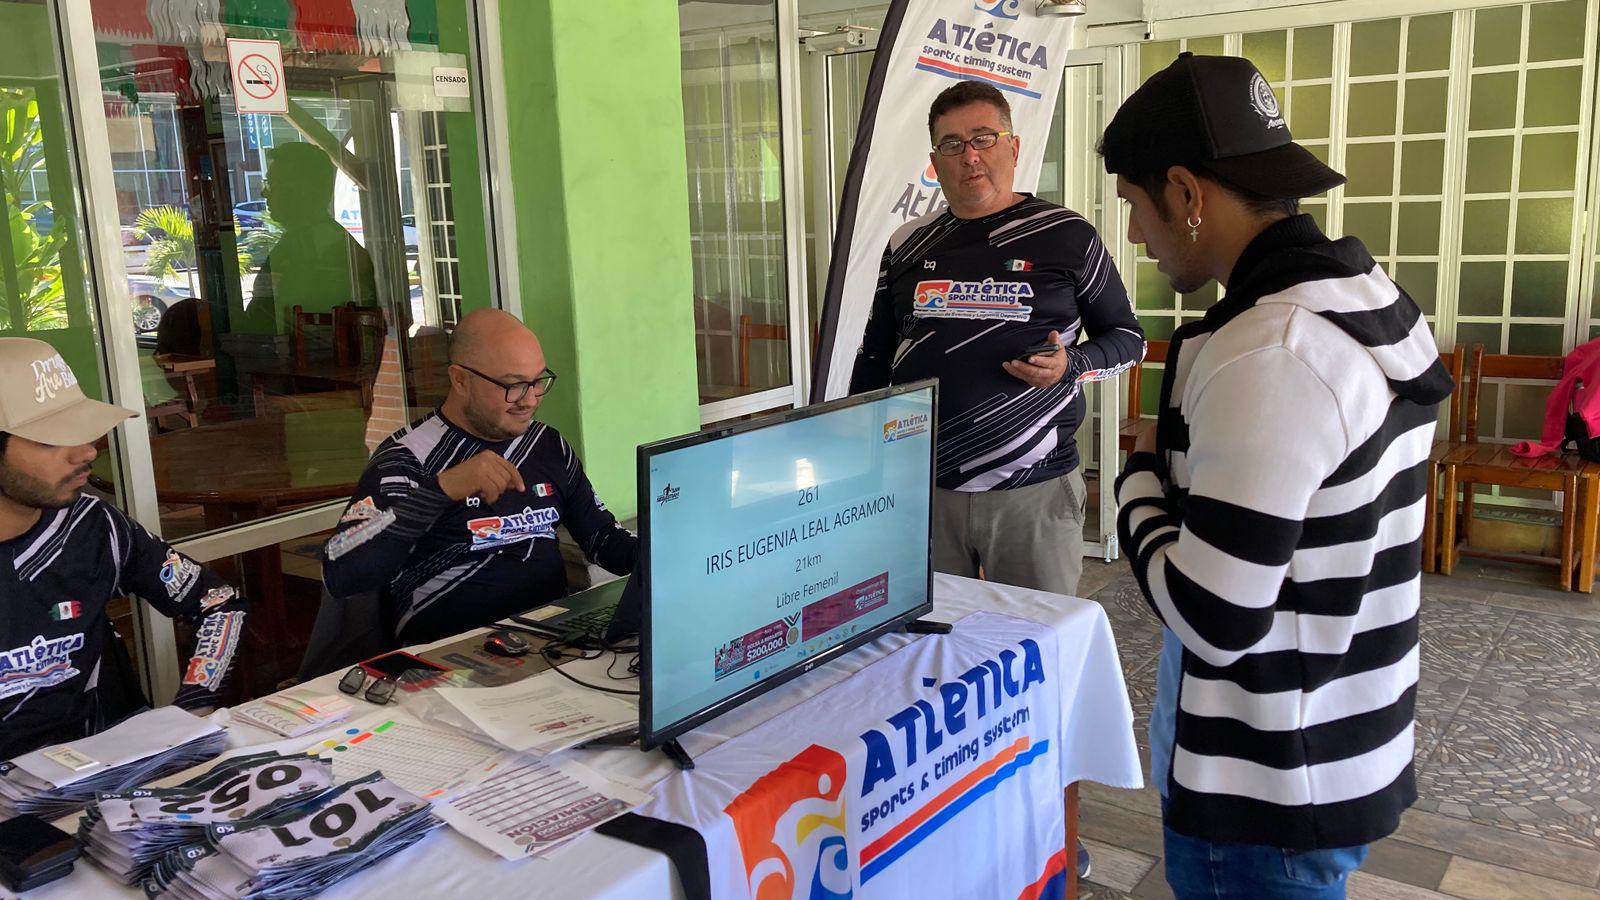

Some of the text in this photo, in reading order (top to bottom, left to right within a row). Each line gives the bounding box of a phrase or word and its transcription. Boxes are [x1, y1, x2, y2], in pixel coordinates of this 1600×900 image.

[922, 45, 954, 60] sports
[963, 55, 995, 72] timing
[997, 63, 1032, 80] system
[435, 75, 467, 84] CENSADO
[948, 293, 1016, 304] sport timing
[798, 484, 820, 506] 261
[500, 522, 551, 535] sport timing
[705, 494, 895, 575] IRIS EUGENIA LEAL AGRAMON
[795, 552, 822, 573] 21km
[776, 587, 801, 609] Libre
[803, 572, 839, 597] Femenil
[746, 637, 784, 662] $200,000
[860, 705, 1031, 833] sports & timing system
[160, 764, 302, 814] 052
[270, 788, 396, 848] 101
